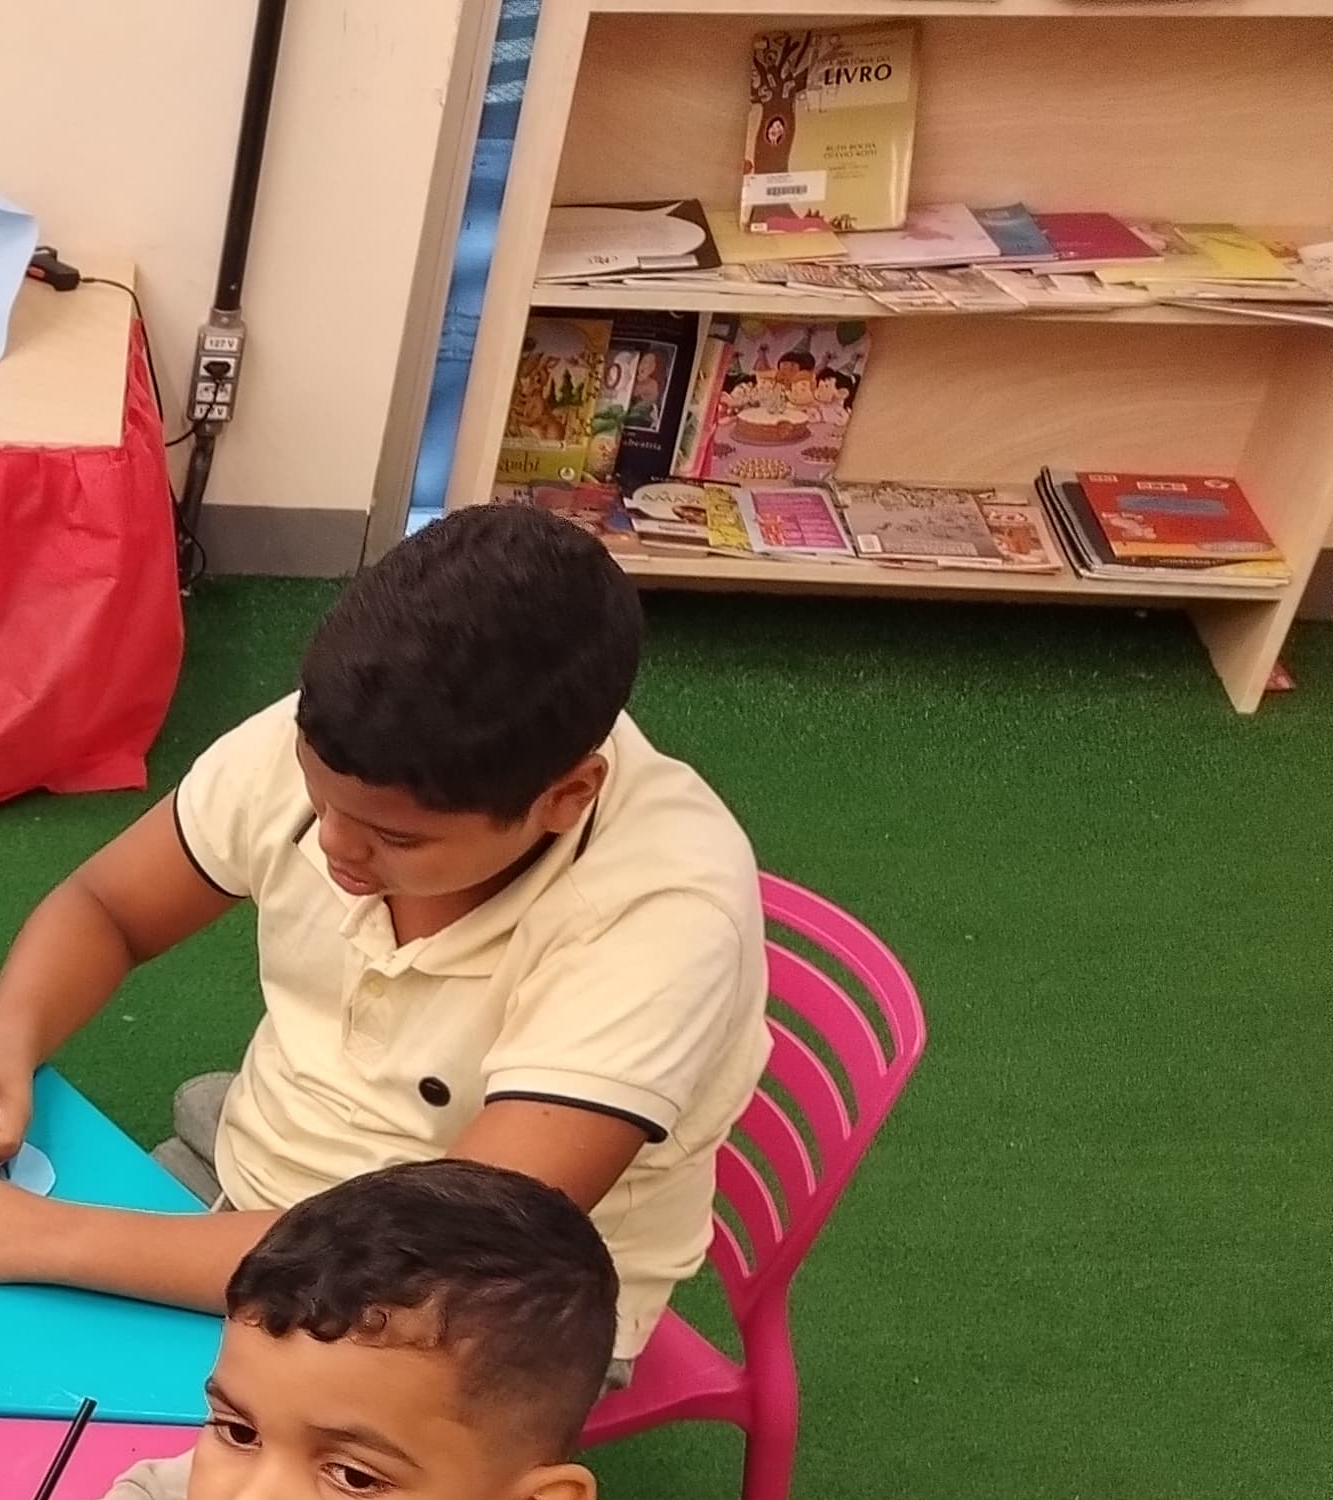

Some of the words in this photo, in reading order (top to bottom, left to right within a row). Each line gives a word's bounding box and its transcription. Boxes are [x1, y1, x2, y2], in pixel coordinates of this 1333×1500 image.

[824, 63, 892, 85] LIVRO
[209, 339, 226, 349] 127
[227, 339, 235, 349] V
